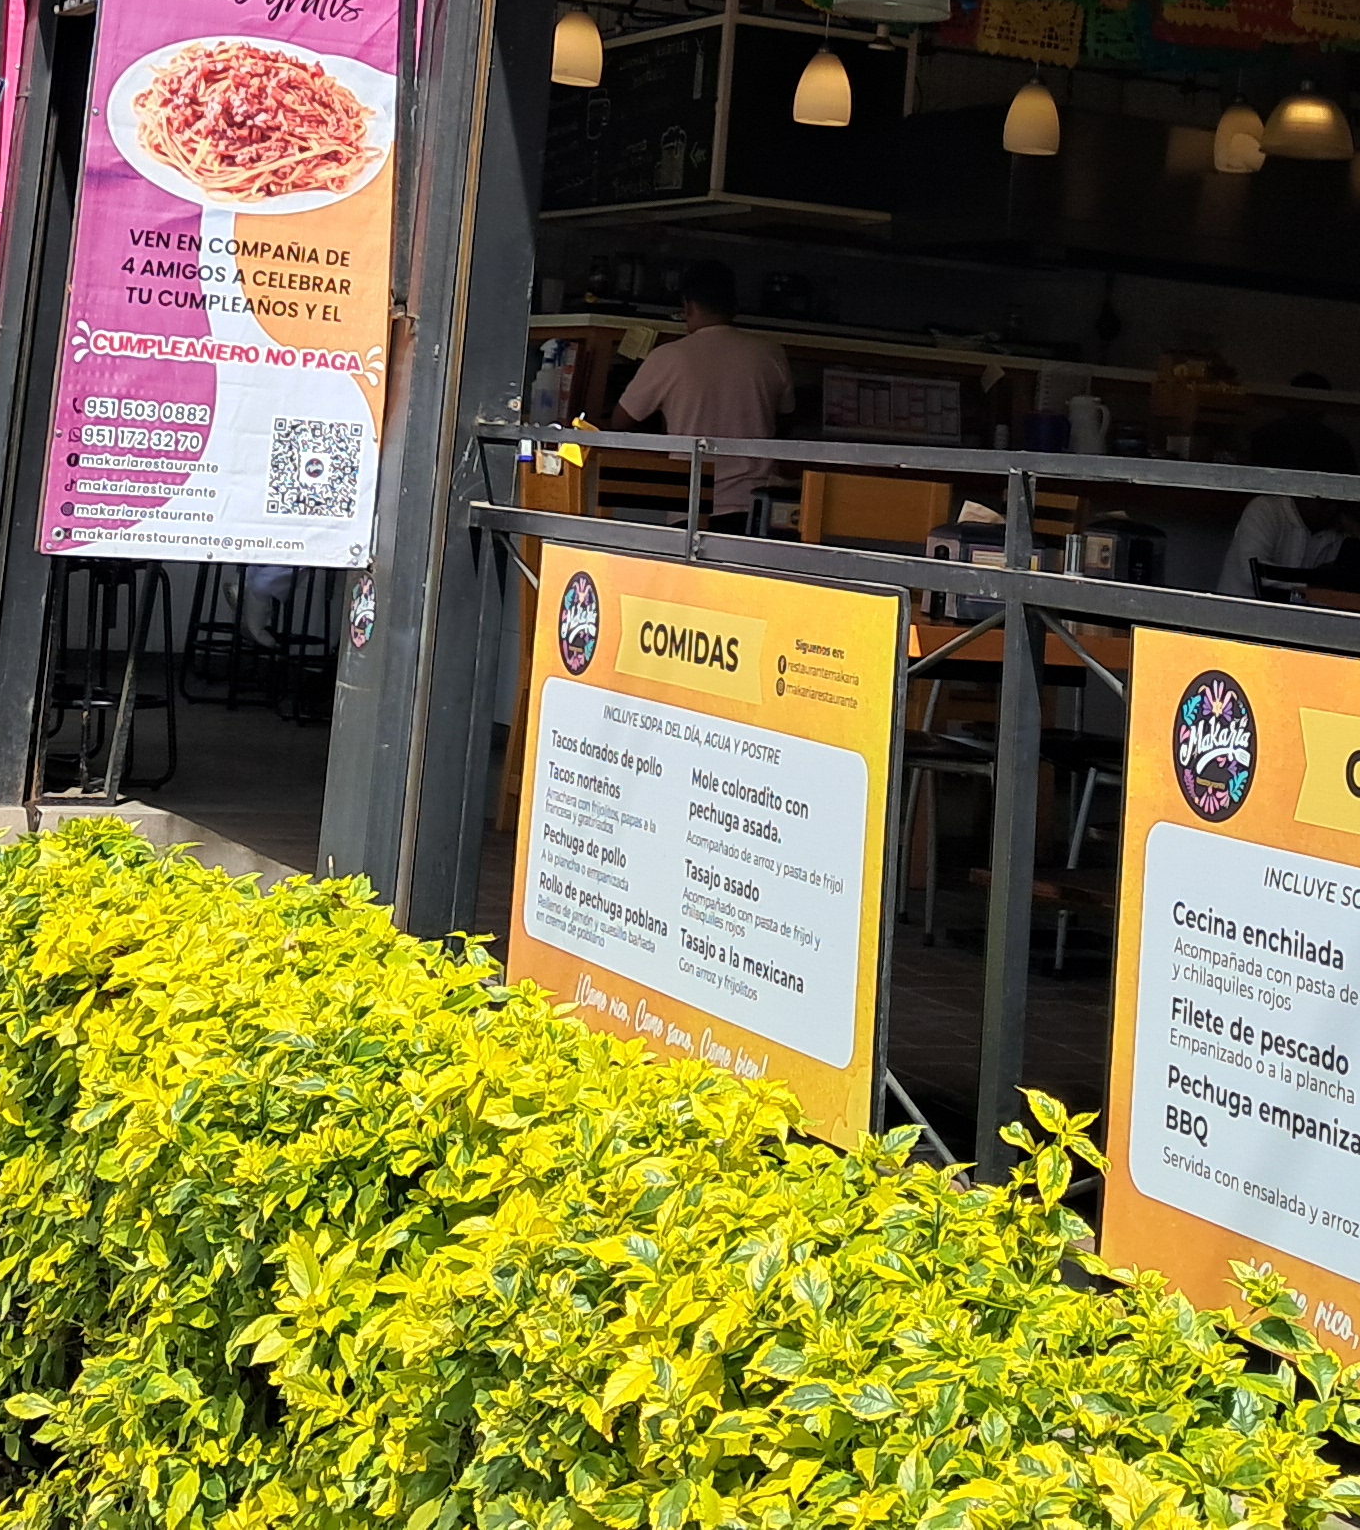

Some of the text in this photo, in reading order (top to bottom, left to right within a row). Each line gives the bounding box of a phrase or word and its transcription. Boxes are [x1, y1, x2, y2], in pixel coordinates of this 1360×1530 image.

[130, 229, 350, 267] VEN EN COMPAÑIA DE
[121, 257, 350, 295] 4 AMIGOS A CELEBRAR
[126, 287, 341, 322] TU CUMPLEAÑOS Y EL
[93, 333, 360, 371] CUMPLEAÑERO NO PAGA
[87, 398, 208, 422] 951 503 0882
[84, 427, 200, 450] 951 172 32 70
[81, 455, 218, 474] makariarestaurante
[79, 480, 216, 498] makariarestaurante
[76, 504, 214, 522] makariarestaurante
[641, 621, 738, 672] COMIDAS
[552, 730, 663, 777] Tacos dorados de pollo
[691, 768, 809, 820] Mole coloradito con
[544, 823, 627, 868] Pechuga de pollo
[684, 859, 760, 902] Tasajo asado
[1263, 867, 1336, 905] INCLUYE
[540, 872, 668, 937] Rollo de pechuga poblana
[1172, 901, 1344, 970] Cecina enchilada
[681, 928, 804, 993] Tasajo a la mexicana
[1174, 937, 1262, 978] Acompañada
[1267, 965, 1292, 987] con
[1296, 972, 1336, 999] pasta
[1339, 984, 1359, 1005] de
[1171, 963, 1292, 1012] y chilaquiles rojos
[1172, 996, 1349, 1075] Filete de pescado
[1170, 1028, 1355, 1105] Empanizado o a la plancha
[1168, 1065, 1252, 1118] Pechuga
[1166, 1105, 1209, 1147] BBQ
[1163, 1146, 1360, 1238] Servida con ensalada y arroz
